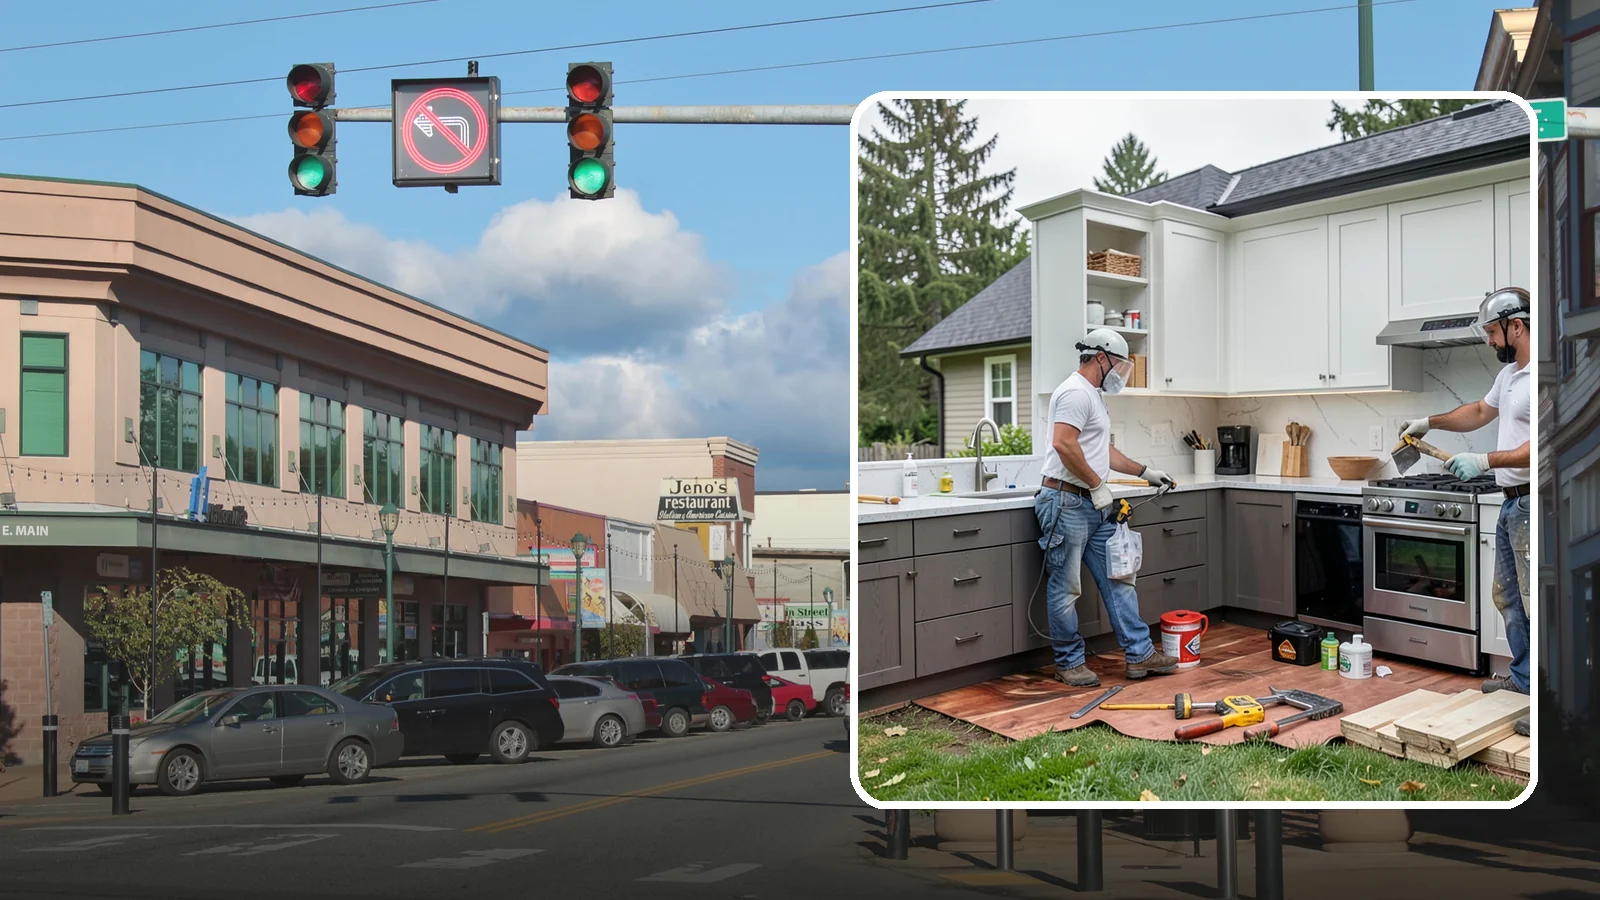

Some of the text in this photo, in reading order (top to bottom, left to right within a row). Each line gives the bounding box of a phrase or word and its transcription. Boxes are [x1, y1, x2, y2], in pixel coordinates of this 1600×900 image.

[670, 480, 727, 494] Jeno's
[665, 496, 730, 508] restaurant
[658, 510, 681, 520] Italian
[686, 510, 714, 519] American
[715, 509, 737, 519] Cuisine
[2, 525, 49, 536] E. MAIN
[798, 608, 828, 616] Street
